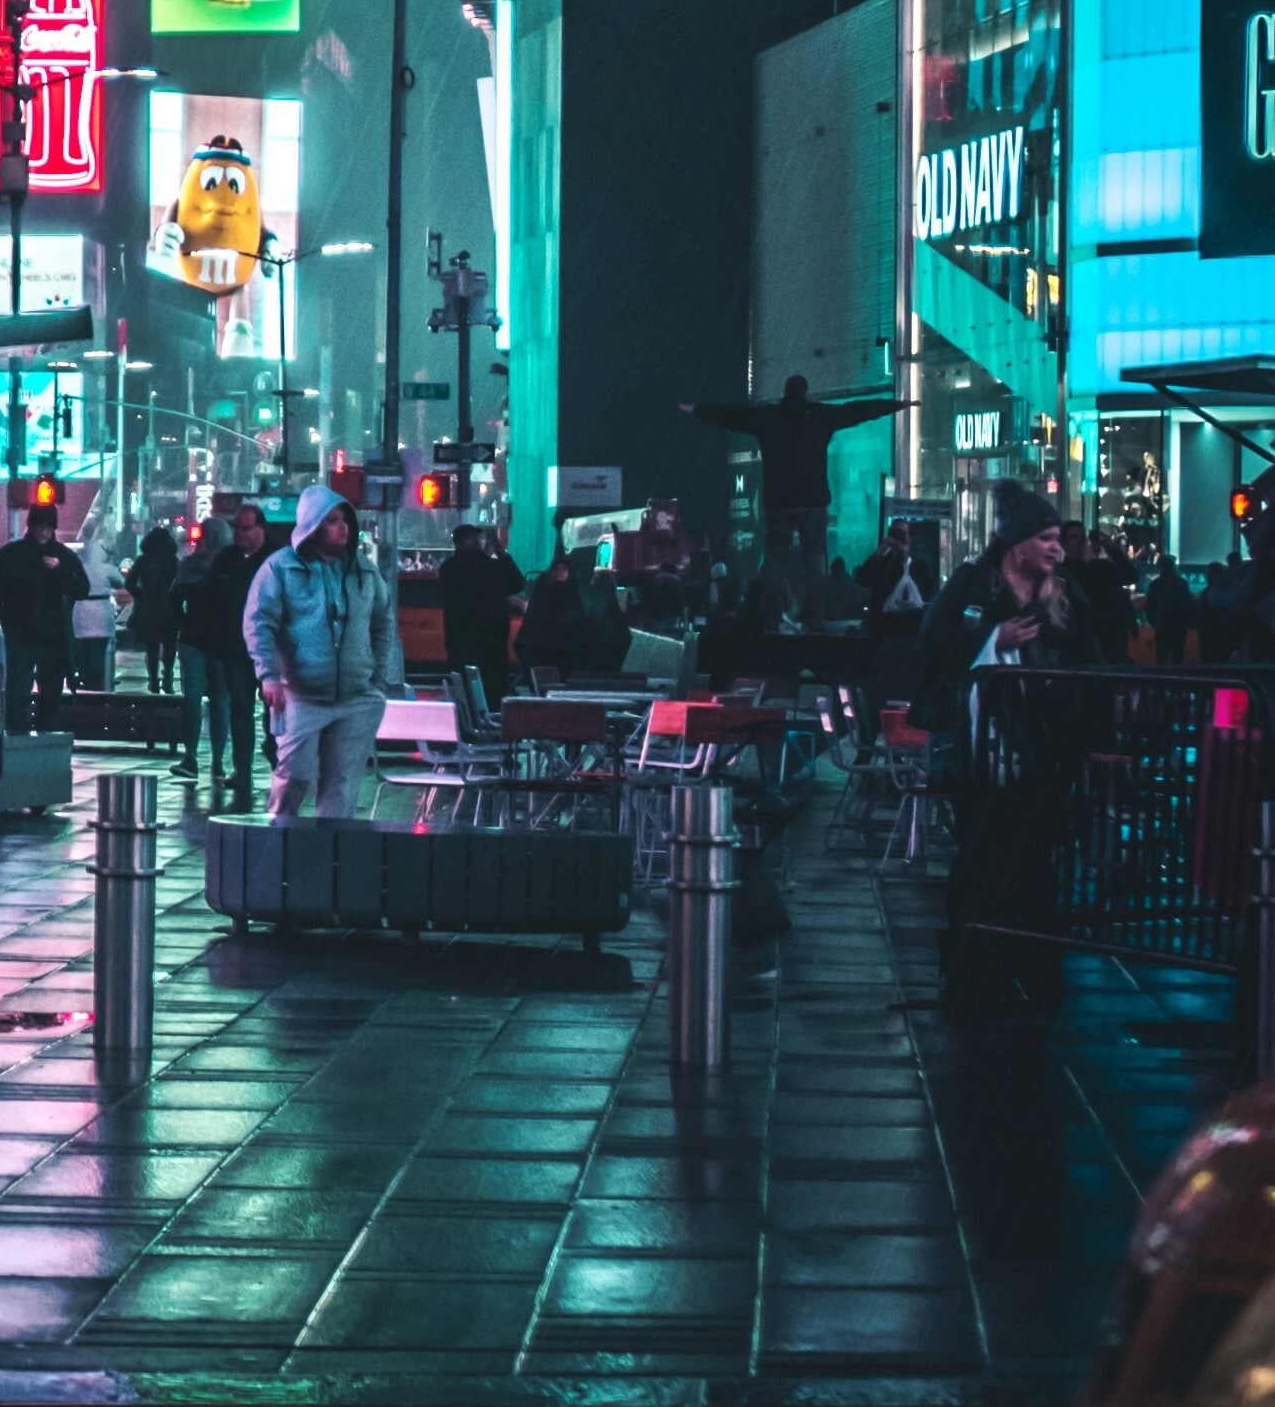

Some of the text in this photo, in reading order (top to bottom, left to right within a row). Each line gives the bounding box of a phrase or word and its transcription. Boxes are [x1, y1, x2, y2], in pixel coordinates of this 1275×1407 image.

[917, 126, 1024, 242] OLD NAVY
[955, 411, 1000, 451] OLD NAVY
